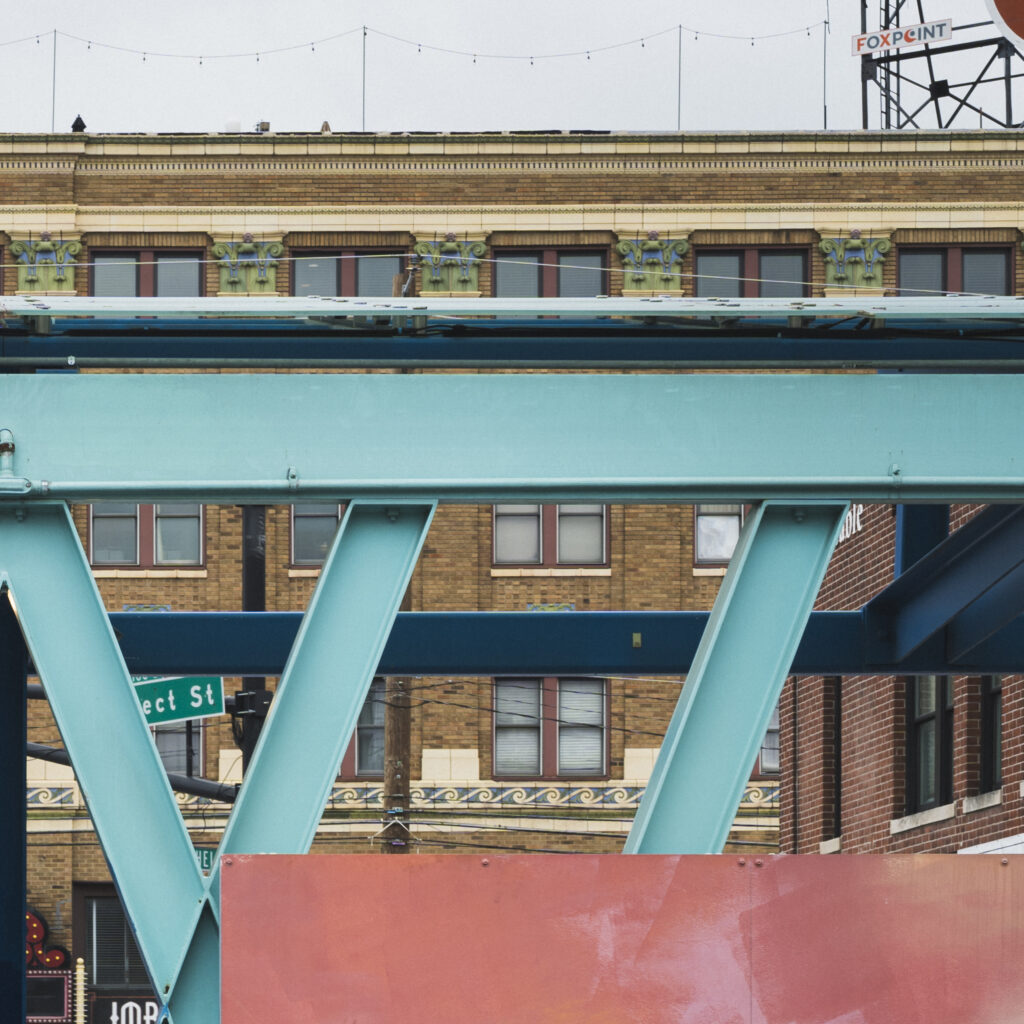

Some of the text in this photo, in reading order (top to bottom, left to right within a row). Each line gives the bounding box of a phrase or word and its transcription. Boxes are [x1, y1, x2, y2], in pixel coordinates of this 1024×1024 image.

[856, 22, 947, 52] FOXPOINT
[142, 683, 215, 715] ect St
